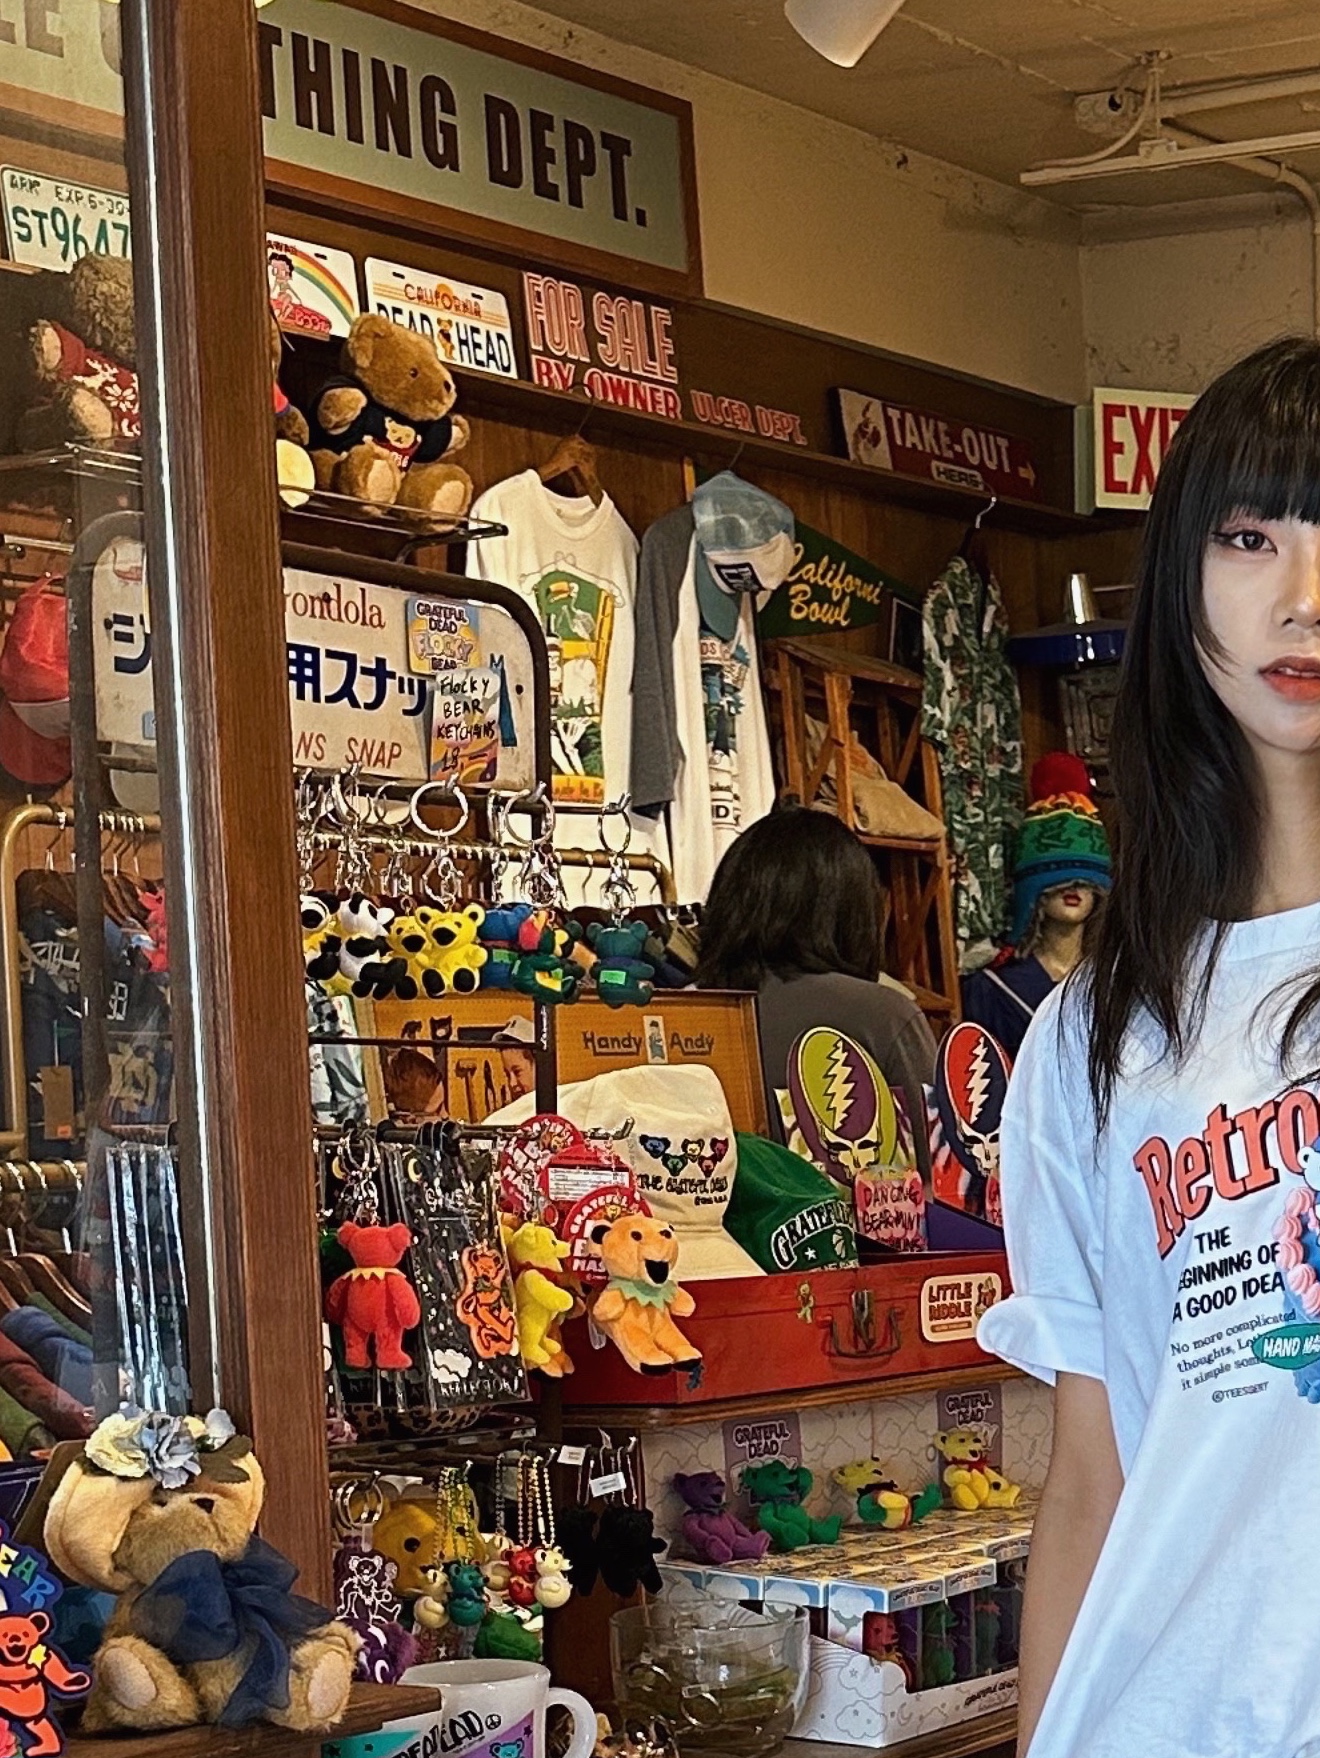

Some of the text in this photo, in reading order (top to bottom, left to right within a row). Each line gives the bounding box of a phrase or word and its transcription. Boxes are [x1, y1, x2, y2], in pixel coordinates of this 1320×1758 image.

[484, 93, 648, 228] DEPT.
[404, 283, 482, 318] CALIFORNIA
[523, 271, 679, 385] FOR SALE
[455, 323, 512, 374] HEAD
[531, 354, 684, 421] BY OWNER
[887, 406, 1012, 474] TAKE-OUT
[284, 583, 386, 629] ondola
[789, 585, 851, 627] Bowl
[429, 618, 458, 634] DEAD
[443, 698, 484, 718] BEAR
[345, 737, 402, 769] SNAP
[583, 1031, 715, 1056] Handy Andy
[1194, 1226, 1232, 1253] THE
[1172, 1272, 1286, 1324] A GOOD IDEA
[1171, 1343, 1190, 1356] No
[1225, 1308, 1297, 1337] complicated
[1262, 1337, 1301, 1358] HAND
[734, 1421, 791, 1444] GRATEFUL
[749, 1437, 780, 1458] DEAD
